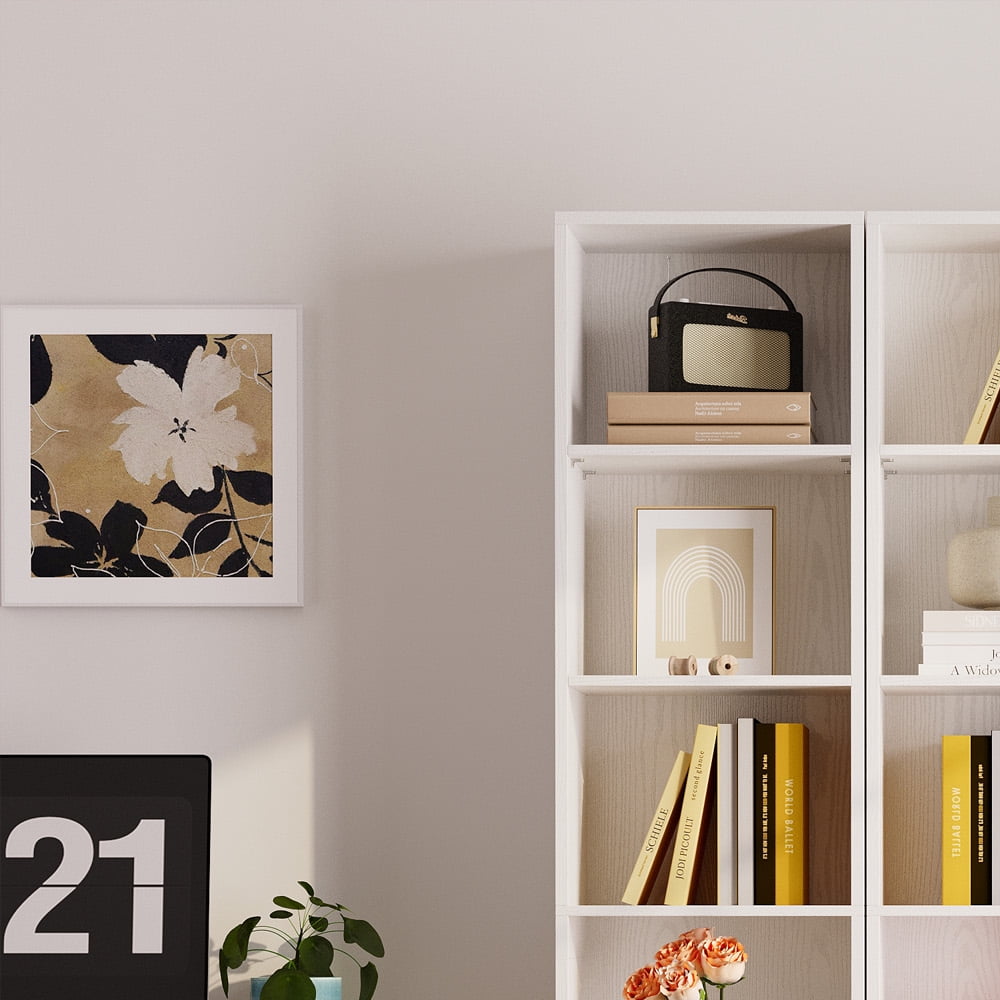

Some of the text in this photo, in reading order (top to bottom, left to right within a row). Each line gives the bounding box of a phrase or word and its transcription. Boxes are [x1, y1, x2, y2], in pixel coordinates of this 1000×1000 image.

[950, 665, 960, 676] A
[691, 750, 704, 800] second glance
[646, 808, 669, 853] SCHIELE
[784, 778, 794, 854] WORLD BALLET
[675, 816, 694, 880] JODI PICOULT
[4, 816, 166, 954] 21
